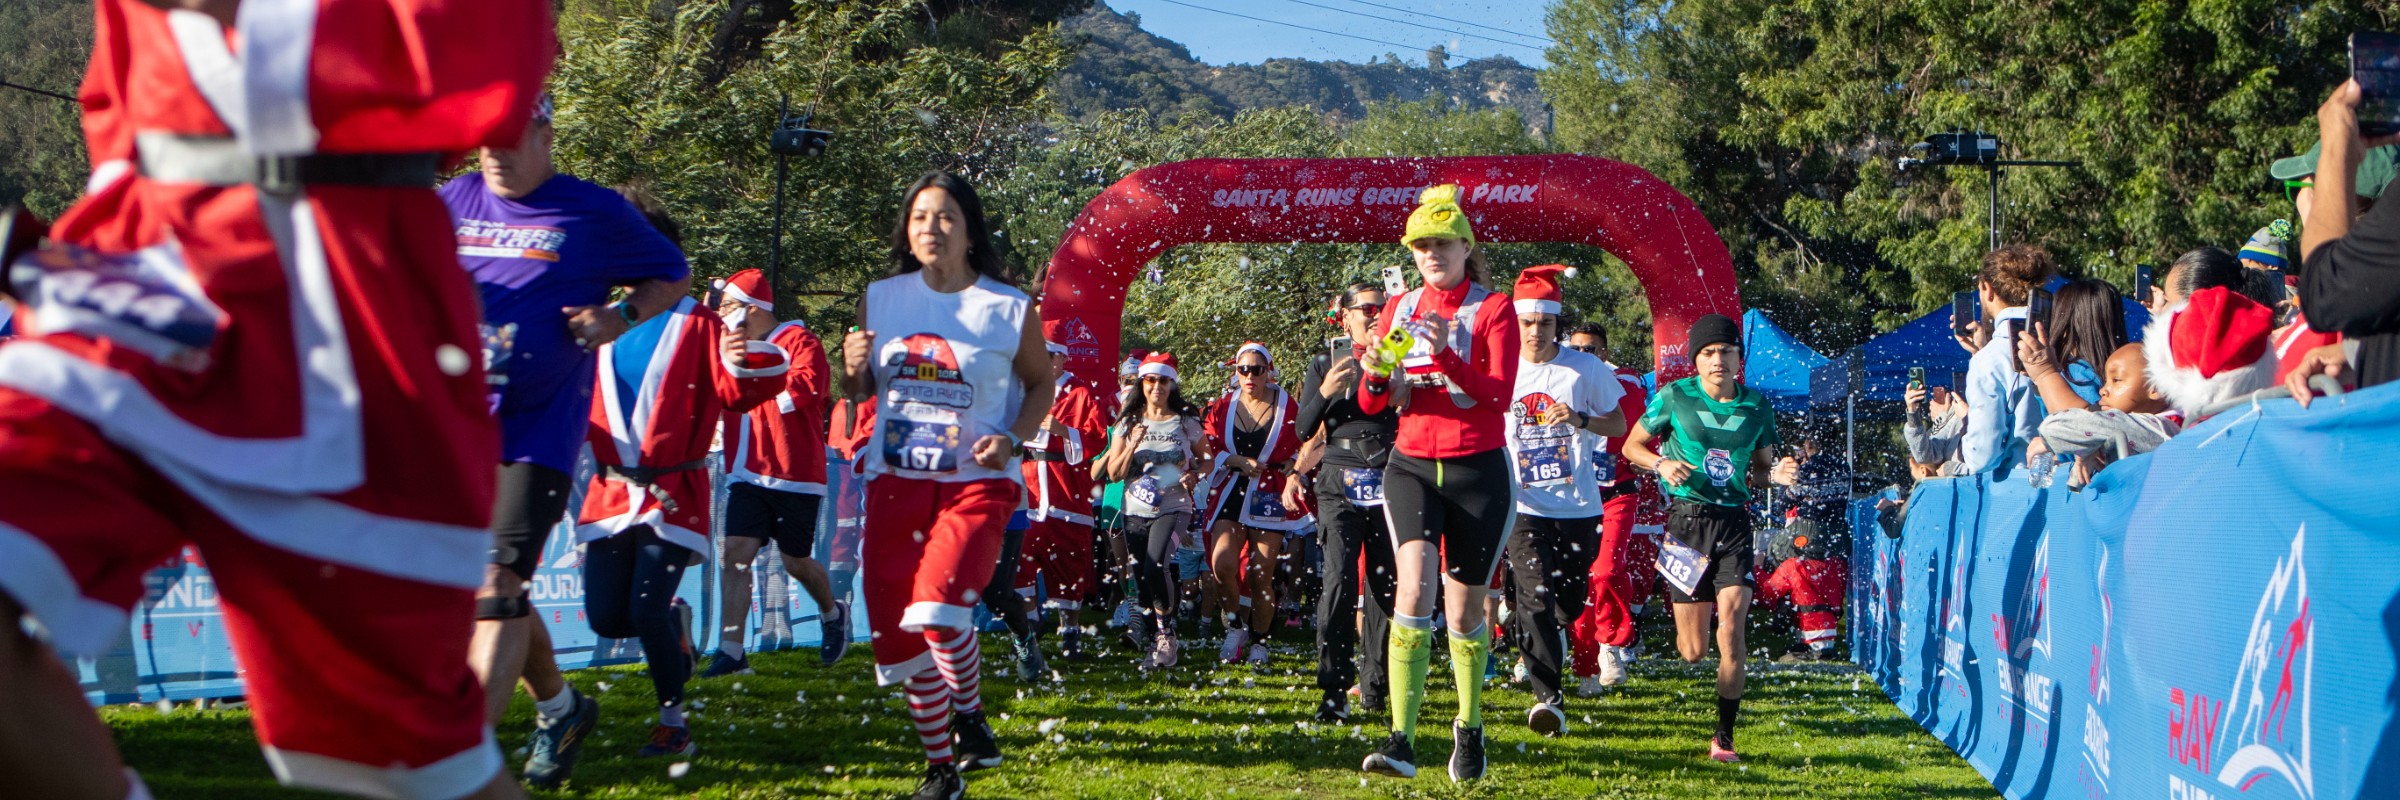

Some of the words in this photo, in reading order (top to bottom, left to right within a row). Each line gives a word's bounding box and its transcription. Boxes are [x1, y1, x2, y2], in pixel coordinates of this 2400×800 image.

[1211, 188, 1287, 208] SANTA
[1294, 187, 1357, 206] RUNS
[1470, 184, 1538, 204] PARK
[459, 217, 506, 228] TEAM
[1068, 347, 1099, 357] ANCE
[1660, 344, 1683, 356] RAY
[903, 366, 917, 375] 5K
[937, 369, 958, 379] 10K
[897, 446, 943, 470] 167
[1530, 462, 1561, 480] 165
[1133, 485, 1155, 504] 393
[1353, 485, 1383, 499] 134
[1664, 554, 1692, 582] 183
[1991, 613, 2013, 655] RAY
[1997, 658, 2050, 714] ENDURANCE
[2168, 687, 2222, 775] RAY
